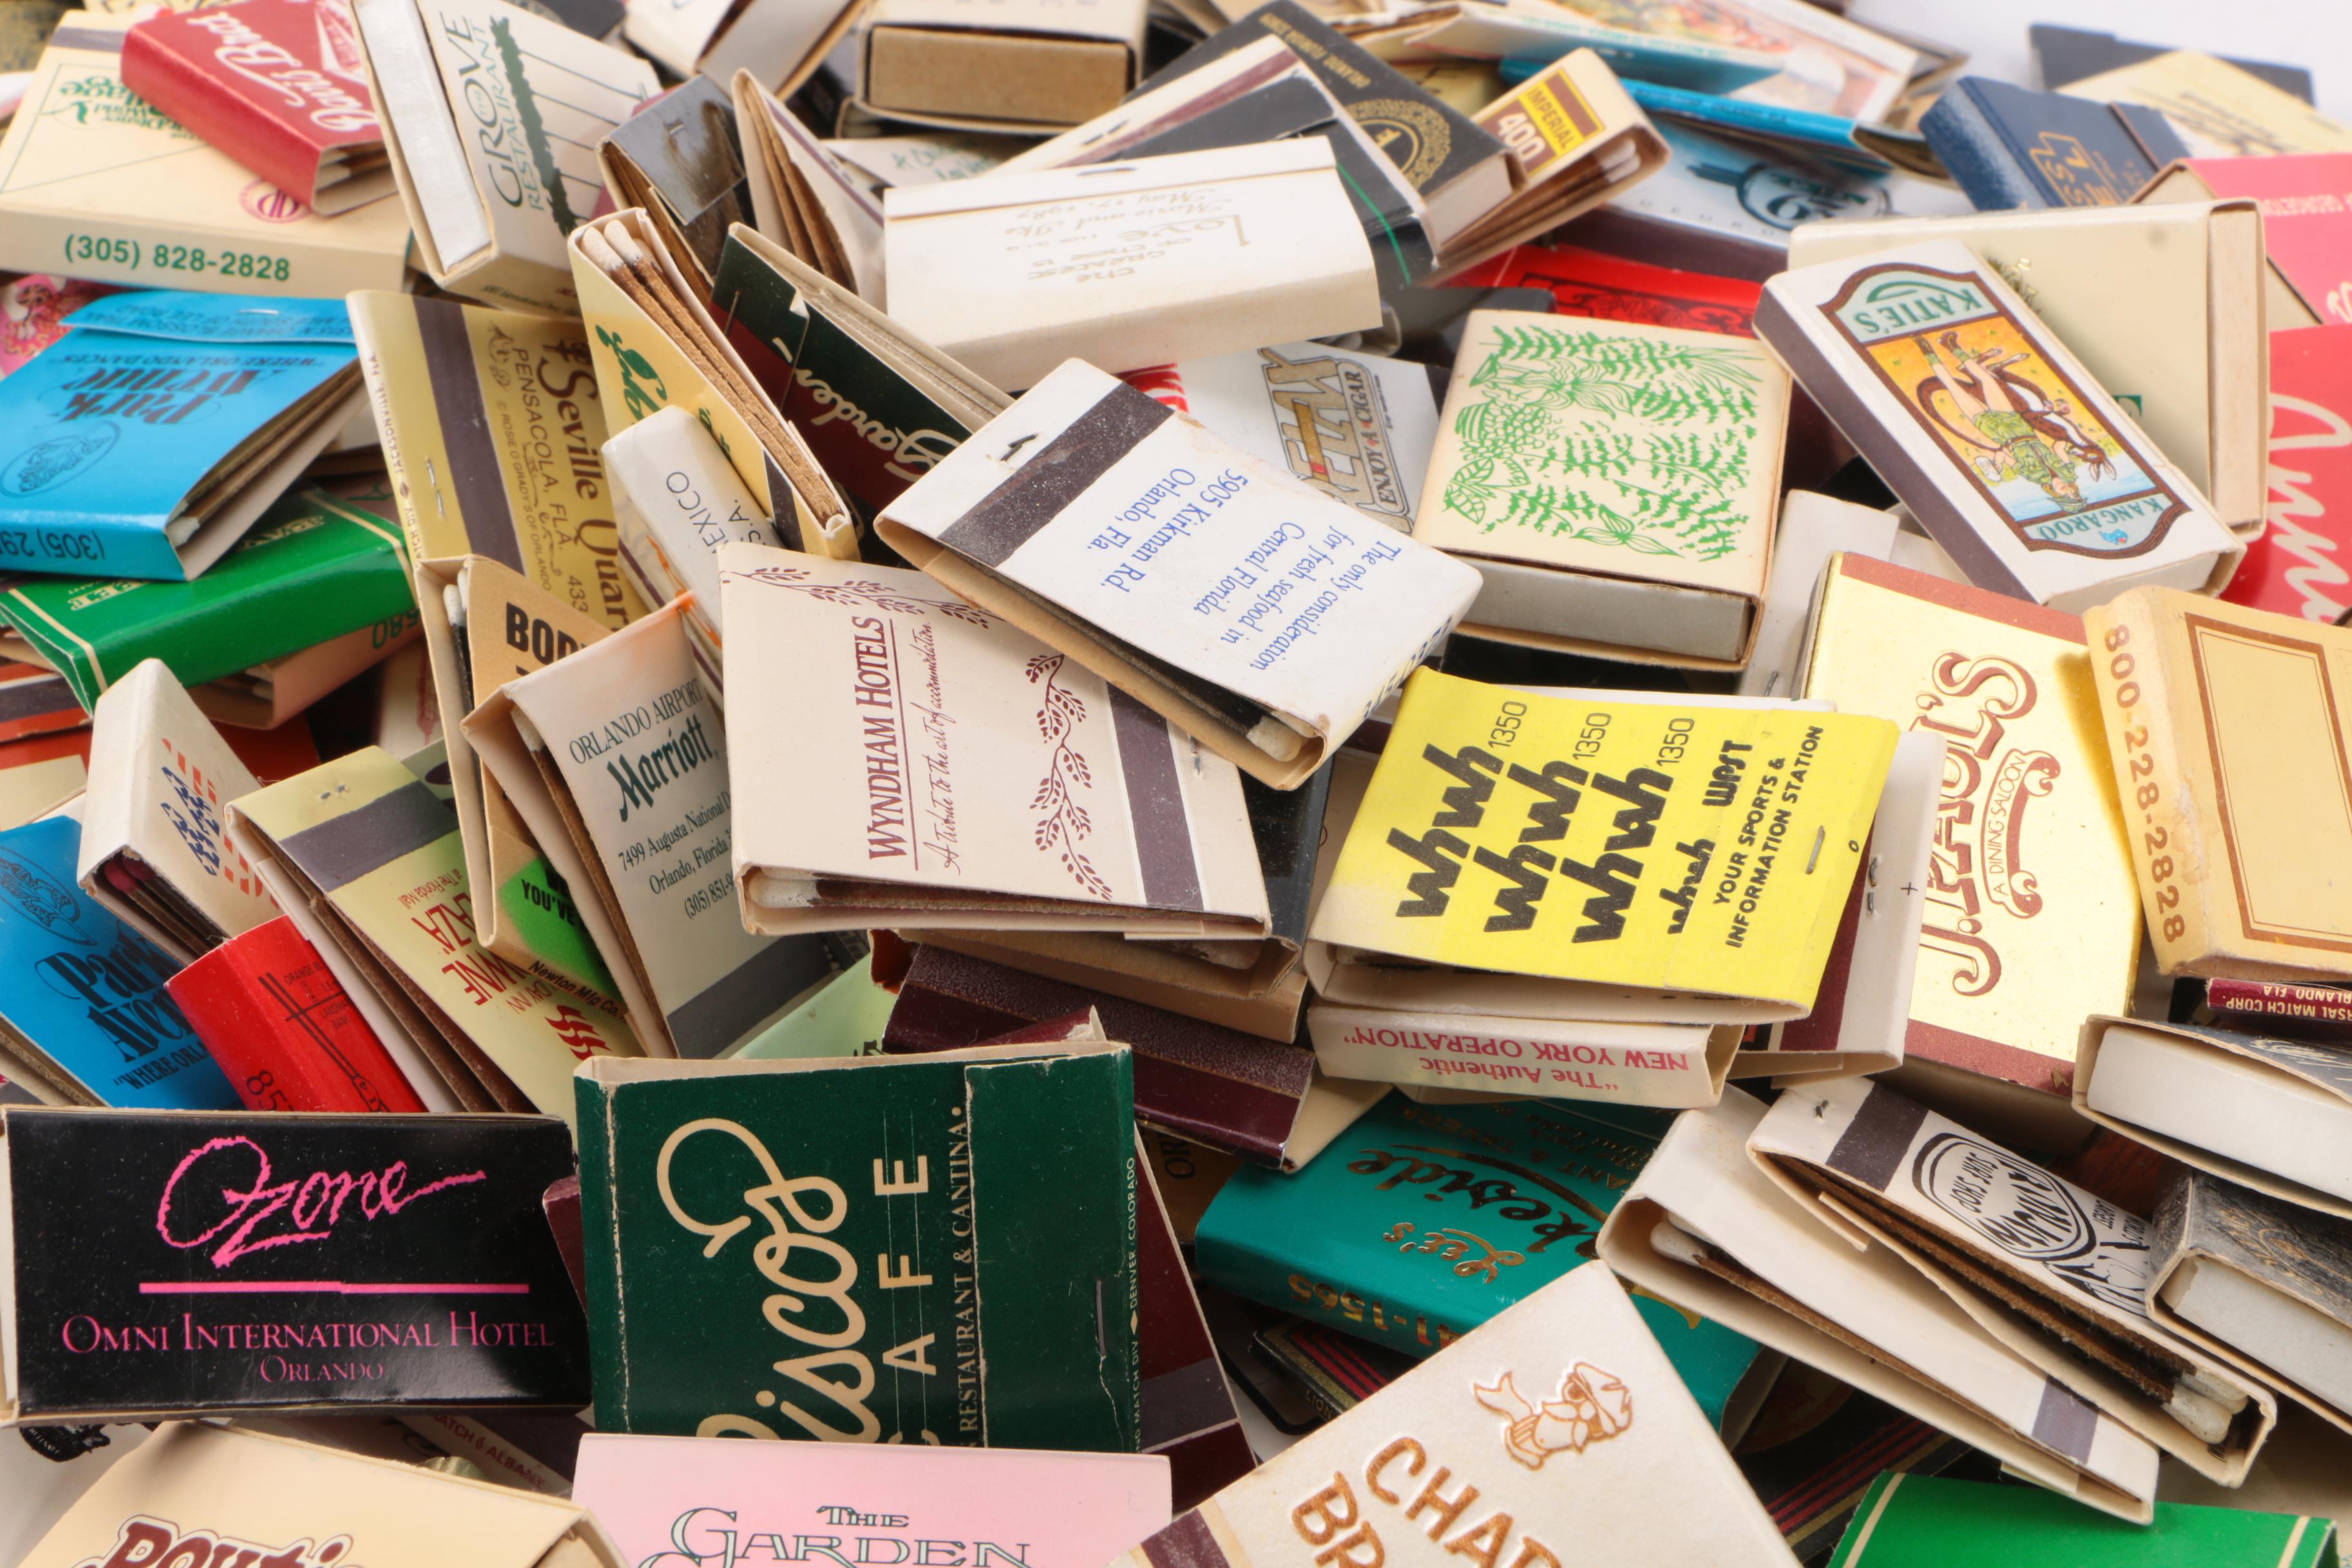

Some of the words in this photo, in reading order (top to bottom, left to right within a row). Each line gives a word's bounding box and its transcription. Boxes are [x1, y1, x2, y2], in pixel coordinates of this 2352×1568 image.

[440, 12, 524, 208] GROVE
[471, 18, 545, 213] RESTAURANT
[1524, 84, 1580, 150] IMPERIAL
[1498, 112, 1546, 164] 400
[64, 234, 142, 270] (305)
[154, 245, 290, 281] 828-2828
[1853, 288, 1985, 335] KATIE'S
[59, 369, 286, 397] Avenue
[1345, 370, 1373, 424] CIGAR
[377, 382, 404, 475] JACKSONVILLE,
[500, 412, 517, 447] ROSIE
[513, 348, 559, 494] PENSACOLA,
[548, 502, 573, 551] FLA.
[536, 357, 605, 501] Seville
[571, 518, 631, 629] Quar
[1115, 468, 1196, 524] Orlando,
[1210, 469, 1248, 508] 5905
[1362, 448, 1397, 506] ENJOY
[525, 514, 538, 531] OF
[665, 471, 727, 556] EXICO
[1139, 502, 1213, 560] Kirkman
[1322, 525, 1355, 550] for
[2036, 496, 2164, 543] KANGAROO
[39, 529, 104, 560] (305)
[1086, 525, 1132, 551] Fla.
[1244, 522, 1306, 573] Central
[1361, 540, 1402, 566] The
[531, 533, 553, 592] ORLANDO
[1100, 563, 1148, 593] Rd.
[1288, 545, 1335, 582] fresh
[1329, 563, 1367, 592] only
[1193, 566, 1259, 616] Florida
[1237, 578, 1294, 633] seafood
[1219, 628, 1250, 645] in
[1249, 589, 1339, 672] consideration
[850, 615, 894, 711] HOTELS
[569, 706, 653, 765] ORLANDO
[652, 678, 703, 722] AIRPORT
[909, 701, 957, 725] of
[1488, 701, 1528, 750] 1350
[1573, 712, 1613, 761] 1350
[1656, 718, 1695, 767] 1350
[606, 713, 714, 823] Marriott
[863, 716, 908, 861] WYNDHAM
[1988, 755, 2025, 816] SALOON
[618, 842, 645, 872] 7499
[647, 824, 689, 857] Augusta
[684, 796, 726, 833] National
[1712, 852, 1749, 905] YOUR
[1738, 774, 1779, 847] SPORTS
[1767, 757, 1787, 770] &
[1725, 808, 1792, 948] INFORMATION
[1781, 725, 1825, 805] STATION
[1987, 816, 2004, 876] DINING
[418, 877, 446, 899] Florida
[440, 872, 460, 888] The
[649, 859, 697, 895] Orlando,
[692, 836, 729, 869] Florida
[397, 890, 422, 911] Mall
[520, 878, 577, 926] YOU'VE
[684, 888, 711, 920] (305)
[1994, 883, 2008, 897] A
[411, 892, 476, 954] LAZA
[34, 919, 183, 1011] Park
[284, 965, 313, 985] ORANGE
[528, 959, 576, 993] Newton
[576, 985, 602, 1007] Mfg
[505, 991, 533, 1015] INN
[2224, 997, 2263, 1012] CORP.
[2269, 1004, 2316, 1017] MATCH
[2295, 989, 2352, 1004] RLANDO
[1419, 1056, 1542, 1084] Authentic
[1531, 1041, 1616, 1067] YORK
[1624, 1048, 1690, 1072] NEW
[1393, 1106, 1514, 1158] TAVERN
[1961, 1152, 1999, 1186] SURF
[1126, 1157, 1139, 1257] COLORADO
[1948, 1175, 1988, 1215] SHOP
[2092, 1199, 2117, 1230] LARGEST
[952, 1248, 974, 1266] &
[1128, 1260, 1140, 1311] DENVER
[62, 1315, 170, 1353] OMNI
[182, 1311, 440, 1351] INTERNATIONAL
[449, 1310, 556, 1350] HOTEL
[952, 1275, 985, 1435] RESTAURANT
[260, 1355, 386, 1383] ORLANDO
[1130, 1375, 1141, 1416] MATCH
[669, 1507, 1030, 1568] GARDEN
[816, 1505, 910, 1528] THE
